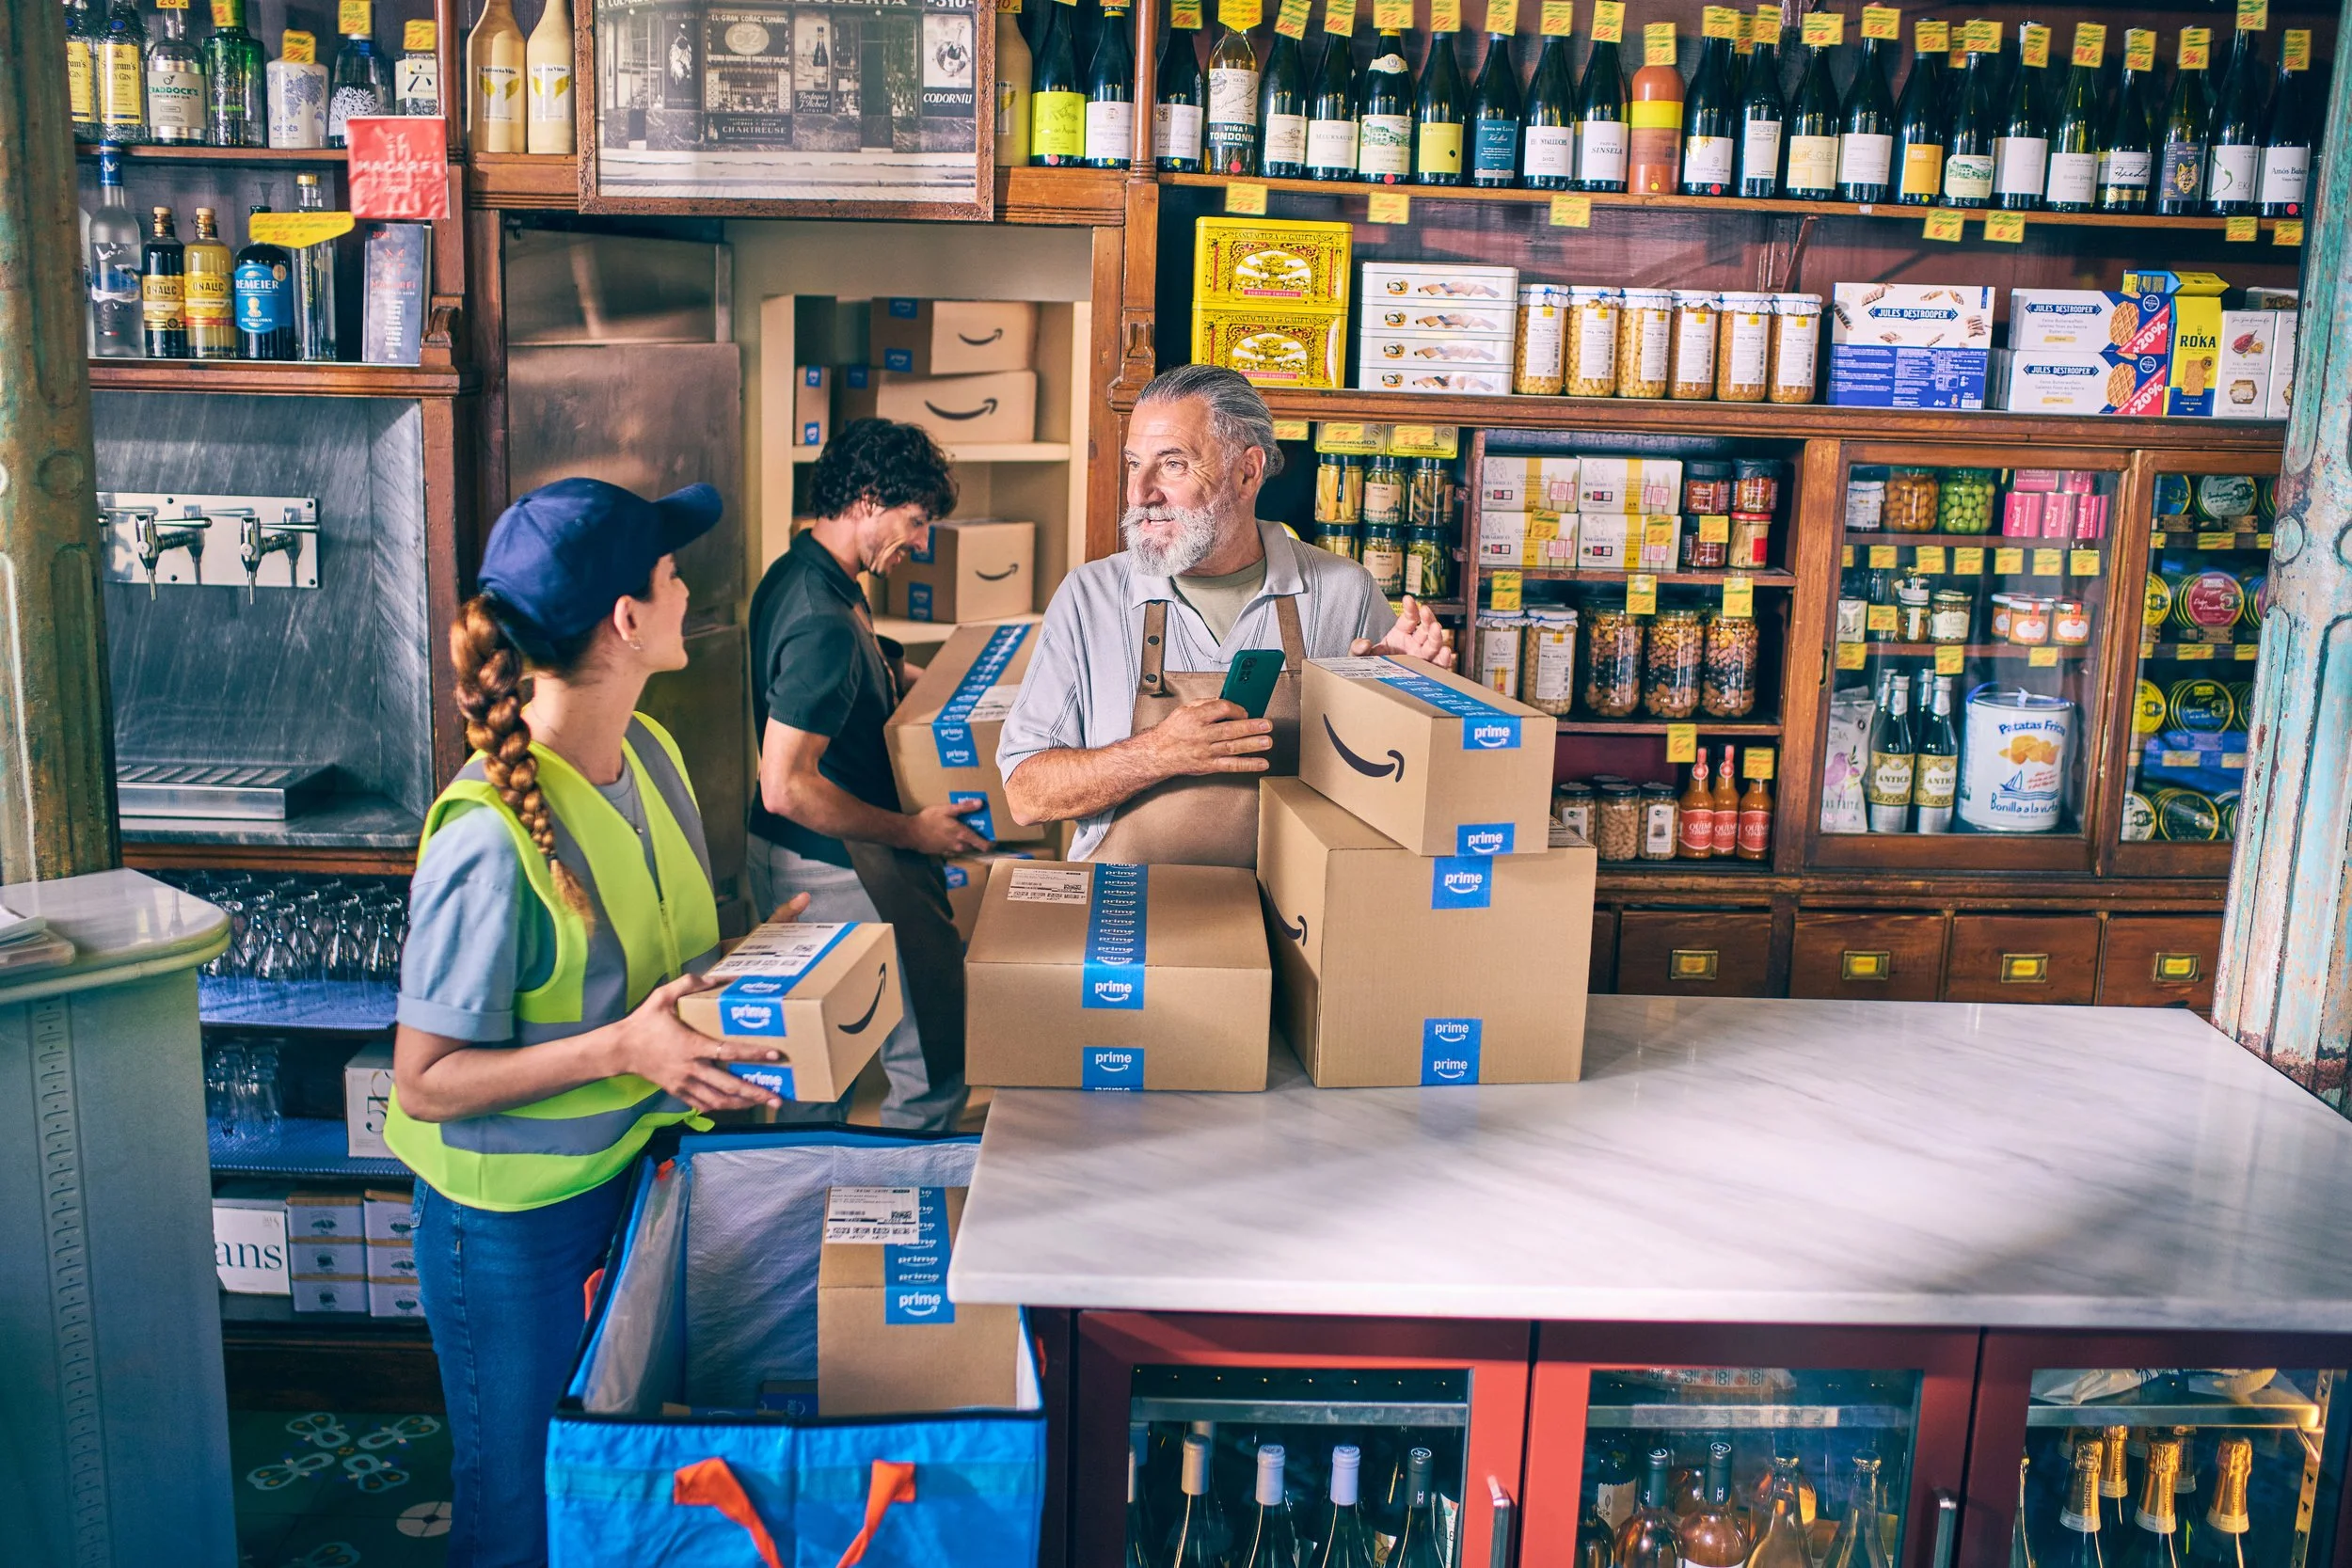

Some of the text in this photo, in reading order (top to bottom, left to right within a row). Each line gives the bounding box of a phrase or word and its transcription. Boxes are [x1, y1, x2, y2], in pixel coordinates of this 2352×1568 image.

[923, 92, 973, 104] CODORNÍU
[722, 126, 787, 135] CHARTREUSE
[1210, 132, 1255, 142] TONDONIA
[1877, 309, 1948, 319] JULES DESTROOPER
[2033, 304, 2093, 313] JULES DESTROOPER
[2179, 335, 2217, 348] ROKA
[2031, 366, 2090, 375] JULES DESTROOPER
[1473, 722, 1510, 740] prime
[1998, 721, 2042, 735] Patatas
[946, 749, 970, 759] prime
[1991, 792, 2023, 813] Bonilla
[2030, 802, 2039, 813] la
[1468, 831, 1503, 847] prime
[1444, 870, 1483, 886] prime
[739, 981, 783, 993] prime
[1094, 980, 1133, 994] prime
[730, 1004, 772, 1020] prime
[1435, 1022, 1470, 1036] prime
[1095, 1051, 1132, 1066] prime
[1434, 1058, 1469, 1072] prime
[365, 1095, 388, 1133] 5
[898, 1256, 939, 1265] prime
[898, 1272, 940, 1282] prime
[898, 1291, 942, 1308] prime
